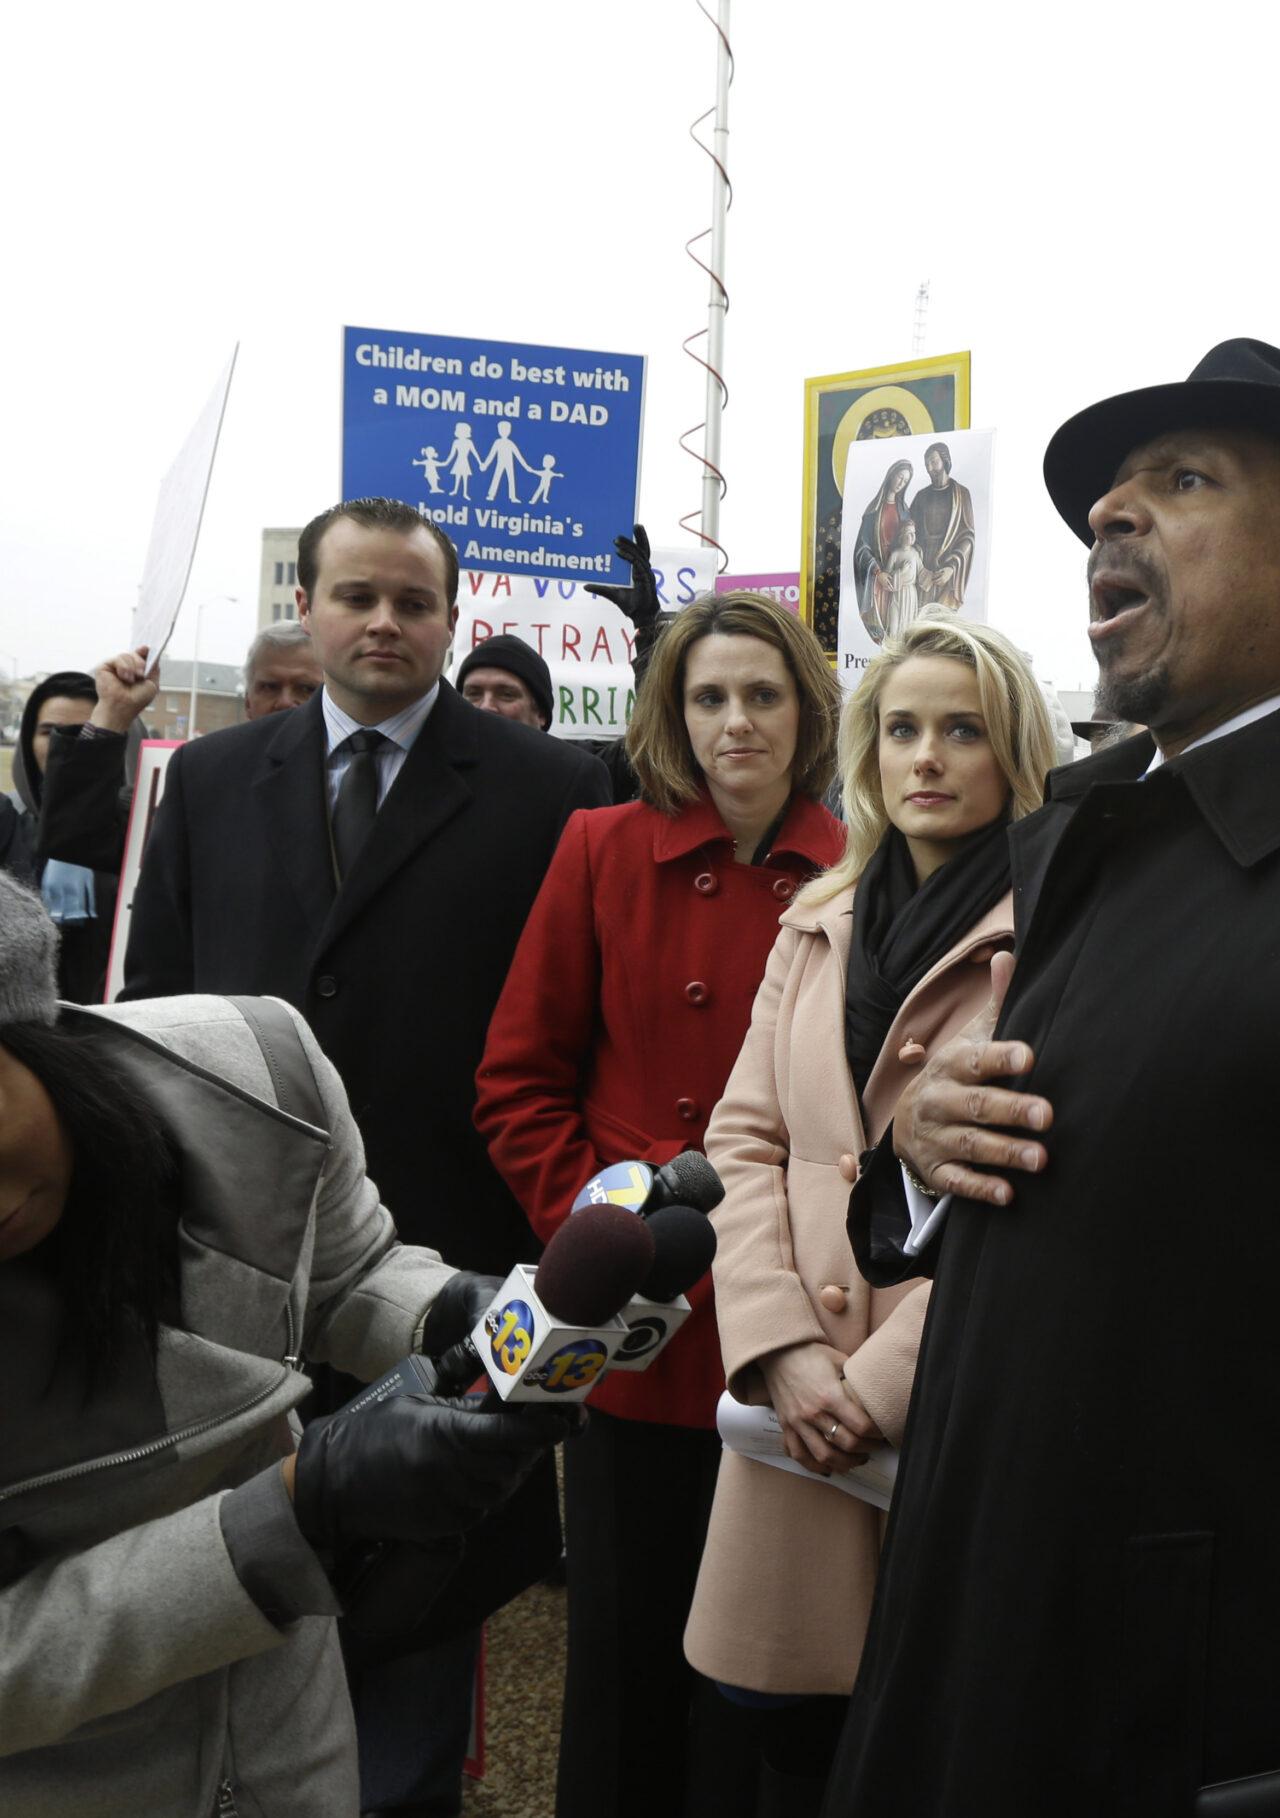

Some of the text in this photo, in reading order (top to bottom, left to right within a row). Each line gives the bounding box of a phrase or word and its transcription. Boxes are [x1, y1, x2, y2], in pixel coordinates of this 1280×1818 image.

[355, 344, 630, 392] Children do best with
[373, 385, 609, 426] a MOM and a DAD
[414, 502, 584, 537] hold Virginia's
[464, 540, 612, 573] Amendment!
[469, 568, 696, 604] VA VORS
[472, 620, 641, 665] BTRAY
[845, 653, 872, 669] Pre
[493, 1309, 531, 1376] 13
[546, 1351, 606, 1388] 13
